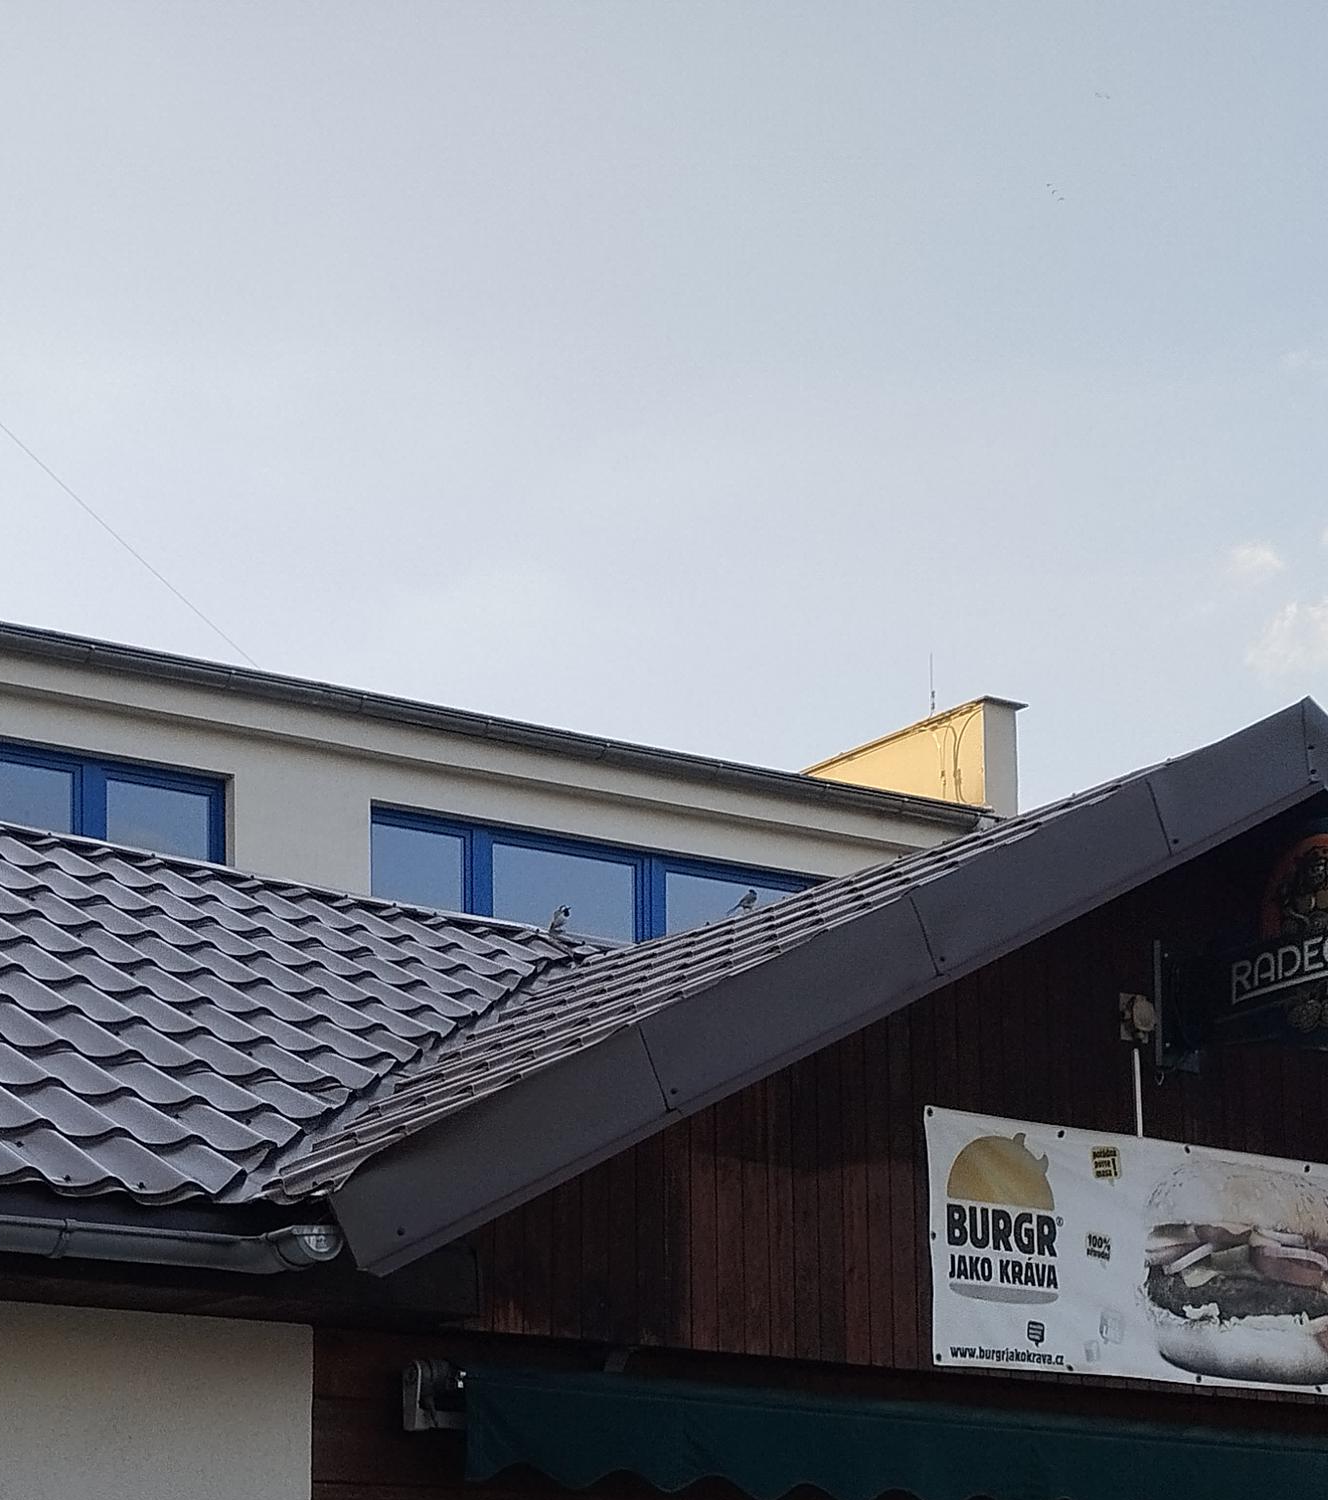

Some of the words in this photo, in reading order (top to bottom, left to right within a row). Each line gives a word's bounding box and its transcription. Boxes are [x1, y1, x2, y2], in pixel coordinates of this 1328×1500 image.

[946, 1204, 1058, 1257] BURGR
[1087, 1233, 1111, 1251] 100%
[949, 1253, 993, 1282] JAKO
[999, 1258, 1059, 1290] KRÁVA
